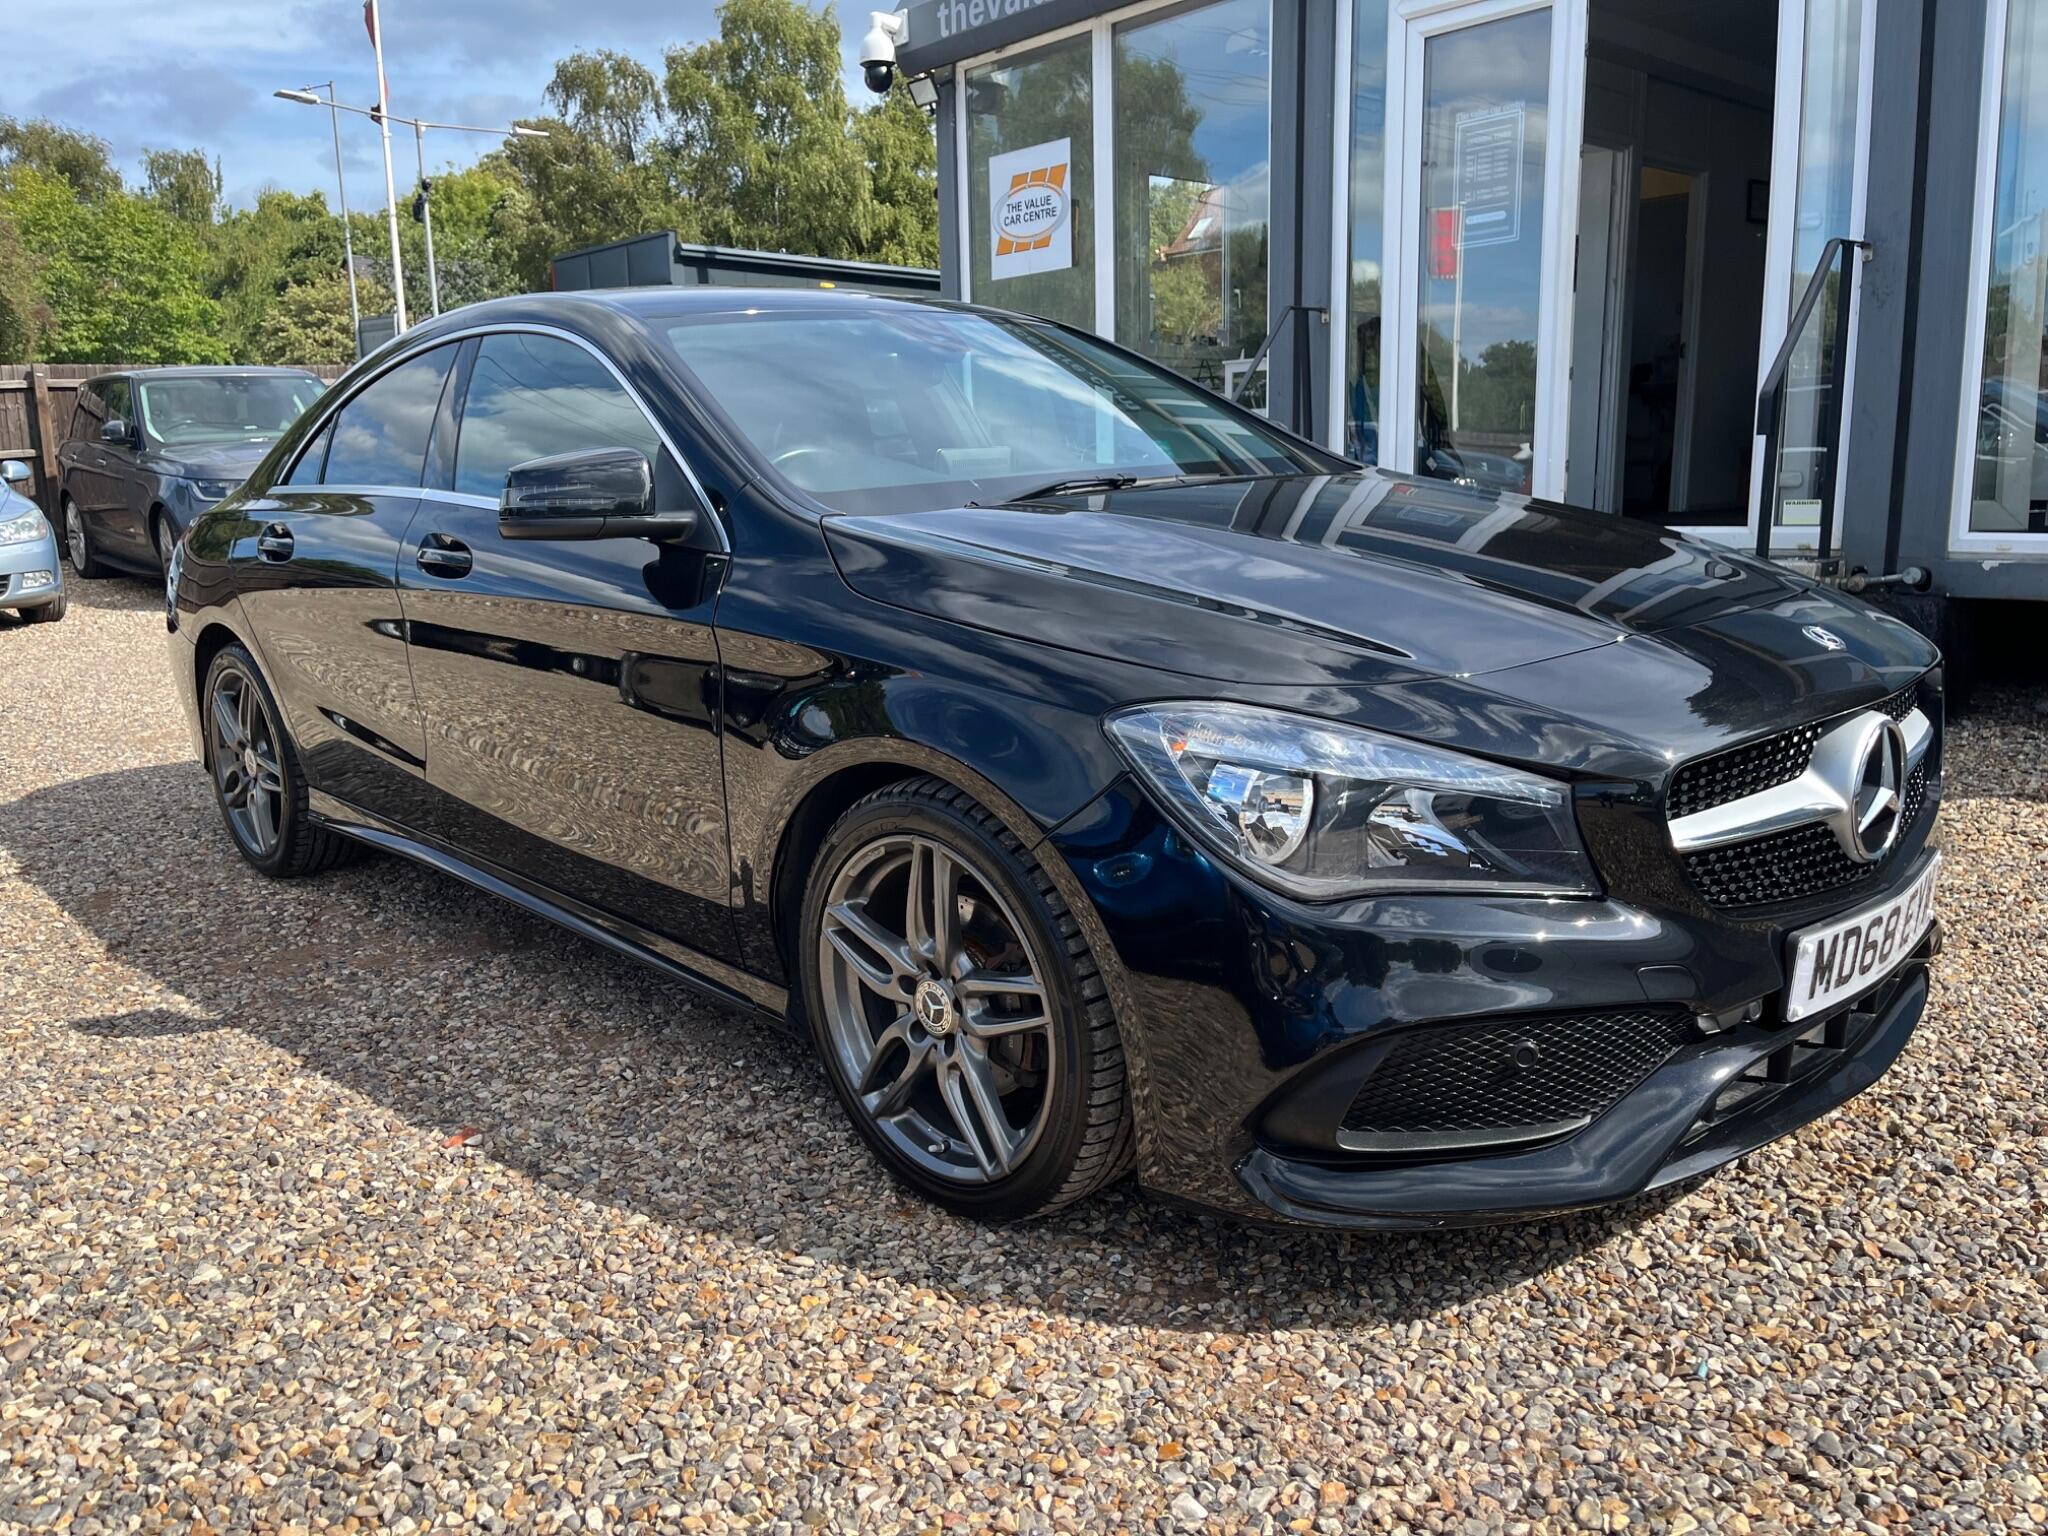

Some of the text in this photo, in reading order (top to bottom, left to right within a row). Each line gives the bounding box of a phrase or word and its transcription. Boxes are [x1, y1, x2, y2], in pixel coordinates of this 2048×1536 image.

[1006, 195, 1052, 214] THE VALUE
[1003, 206, 1057, 227] CAR CENTRE
[1808, 905, 1902, 1000] MD68
